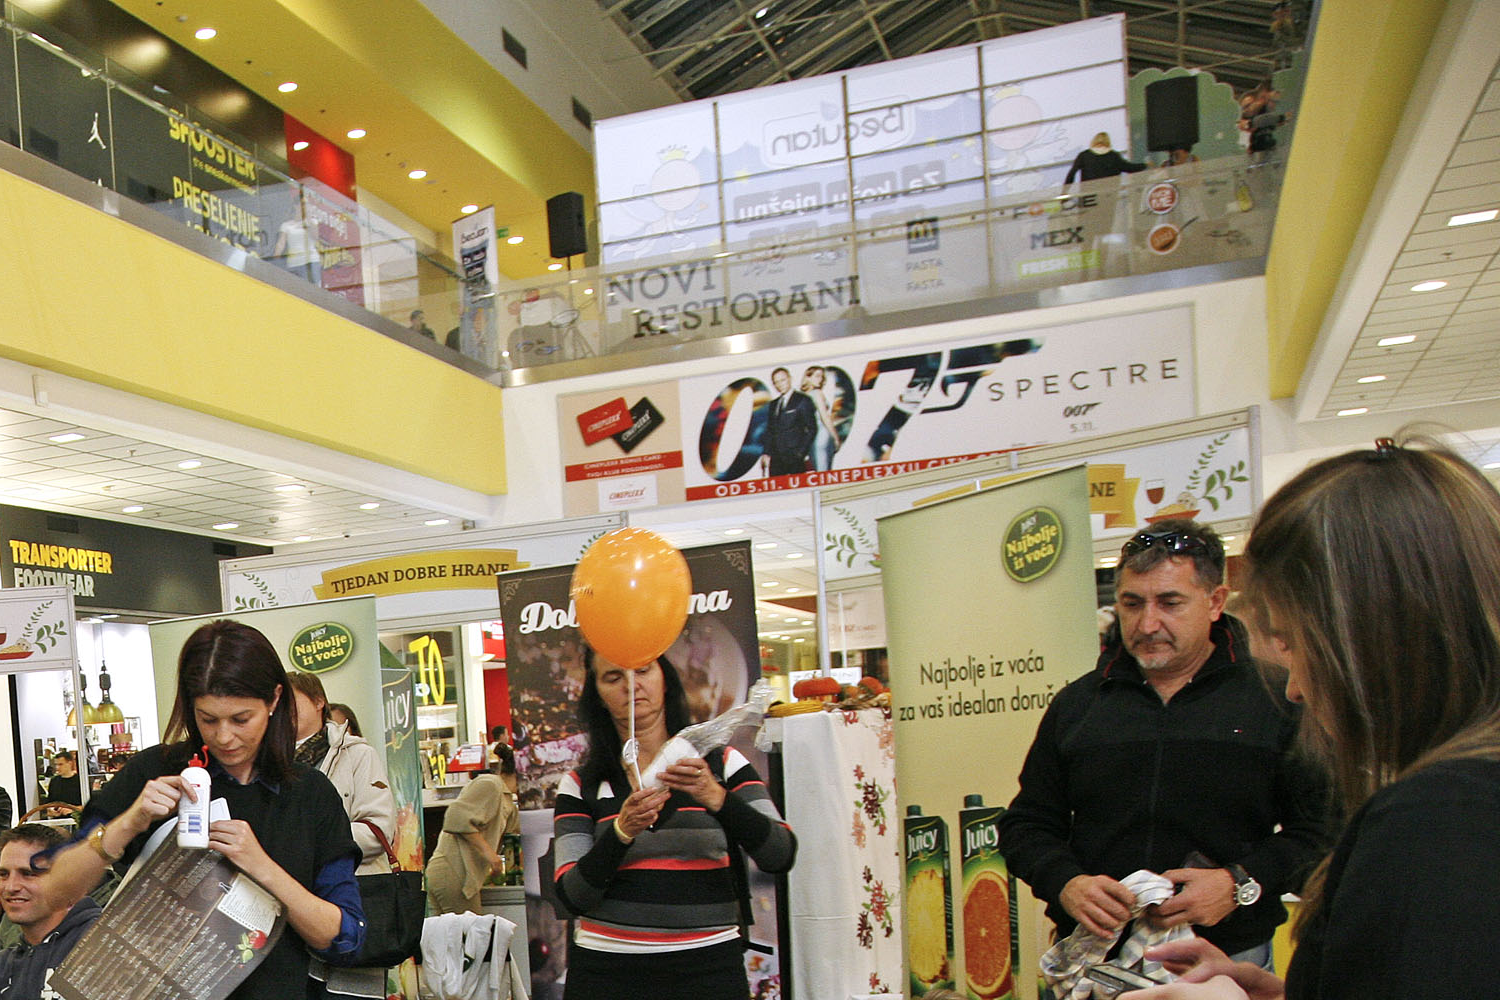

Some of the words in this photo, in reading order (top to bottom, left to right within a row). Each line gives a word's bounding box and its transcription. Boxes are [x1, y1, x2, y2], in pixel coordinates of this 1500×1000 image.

[1030, 226, 1085, 250] MEX
[604, 258, 717, 307] NOVI
[631, 274, 861, 339] RESTORANI
[987, 358, 1180, 402] SPECTRE
[715, 482, 742, 498] OD
[747, 477, 783, 495] 5.11.
[789, 474, 800, 487] U
[8, 539, 114, 574] TRANSPORTER
[330, 571, 390, 594] TJEDAN
[393, 564, 448, 583] DOBRE
[294, 633, 349, 657] Najbolje
[302, 654, 315, 666] iz
[314, 645, 345, 662] voća
[920, 655, 986, 690] Najbolje
[990, 654, 1004, 677] iz
[1007, 649, 1045, 674] voća
[384, 689, 411, 733] uicy
[899, 706, 916, 722] za
[919, 696, 944, 719] vaš
[948, 689, 1007, 717] idealan
[906, 828, 939, 859] Juicy
